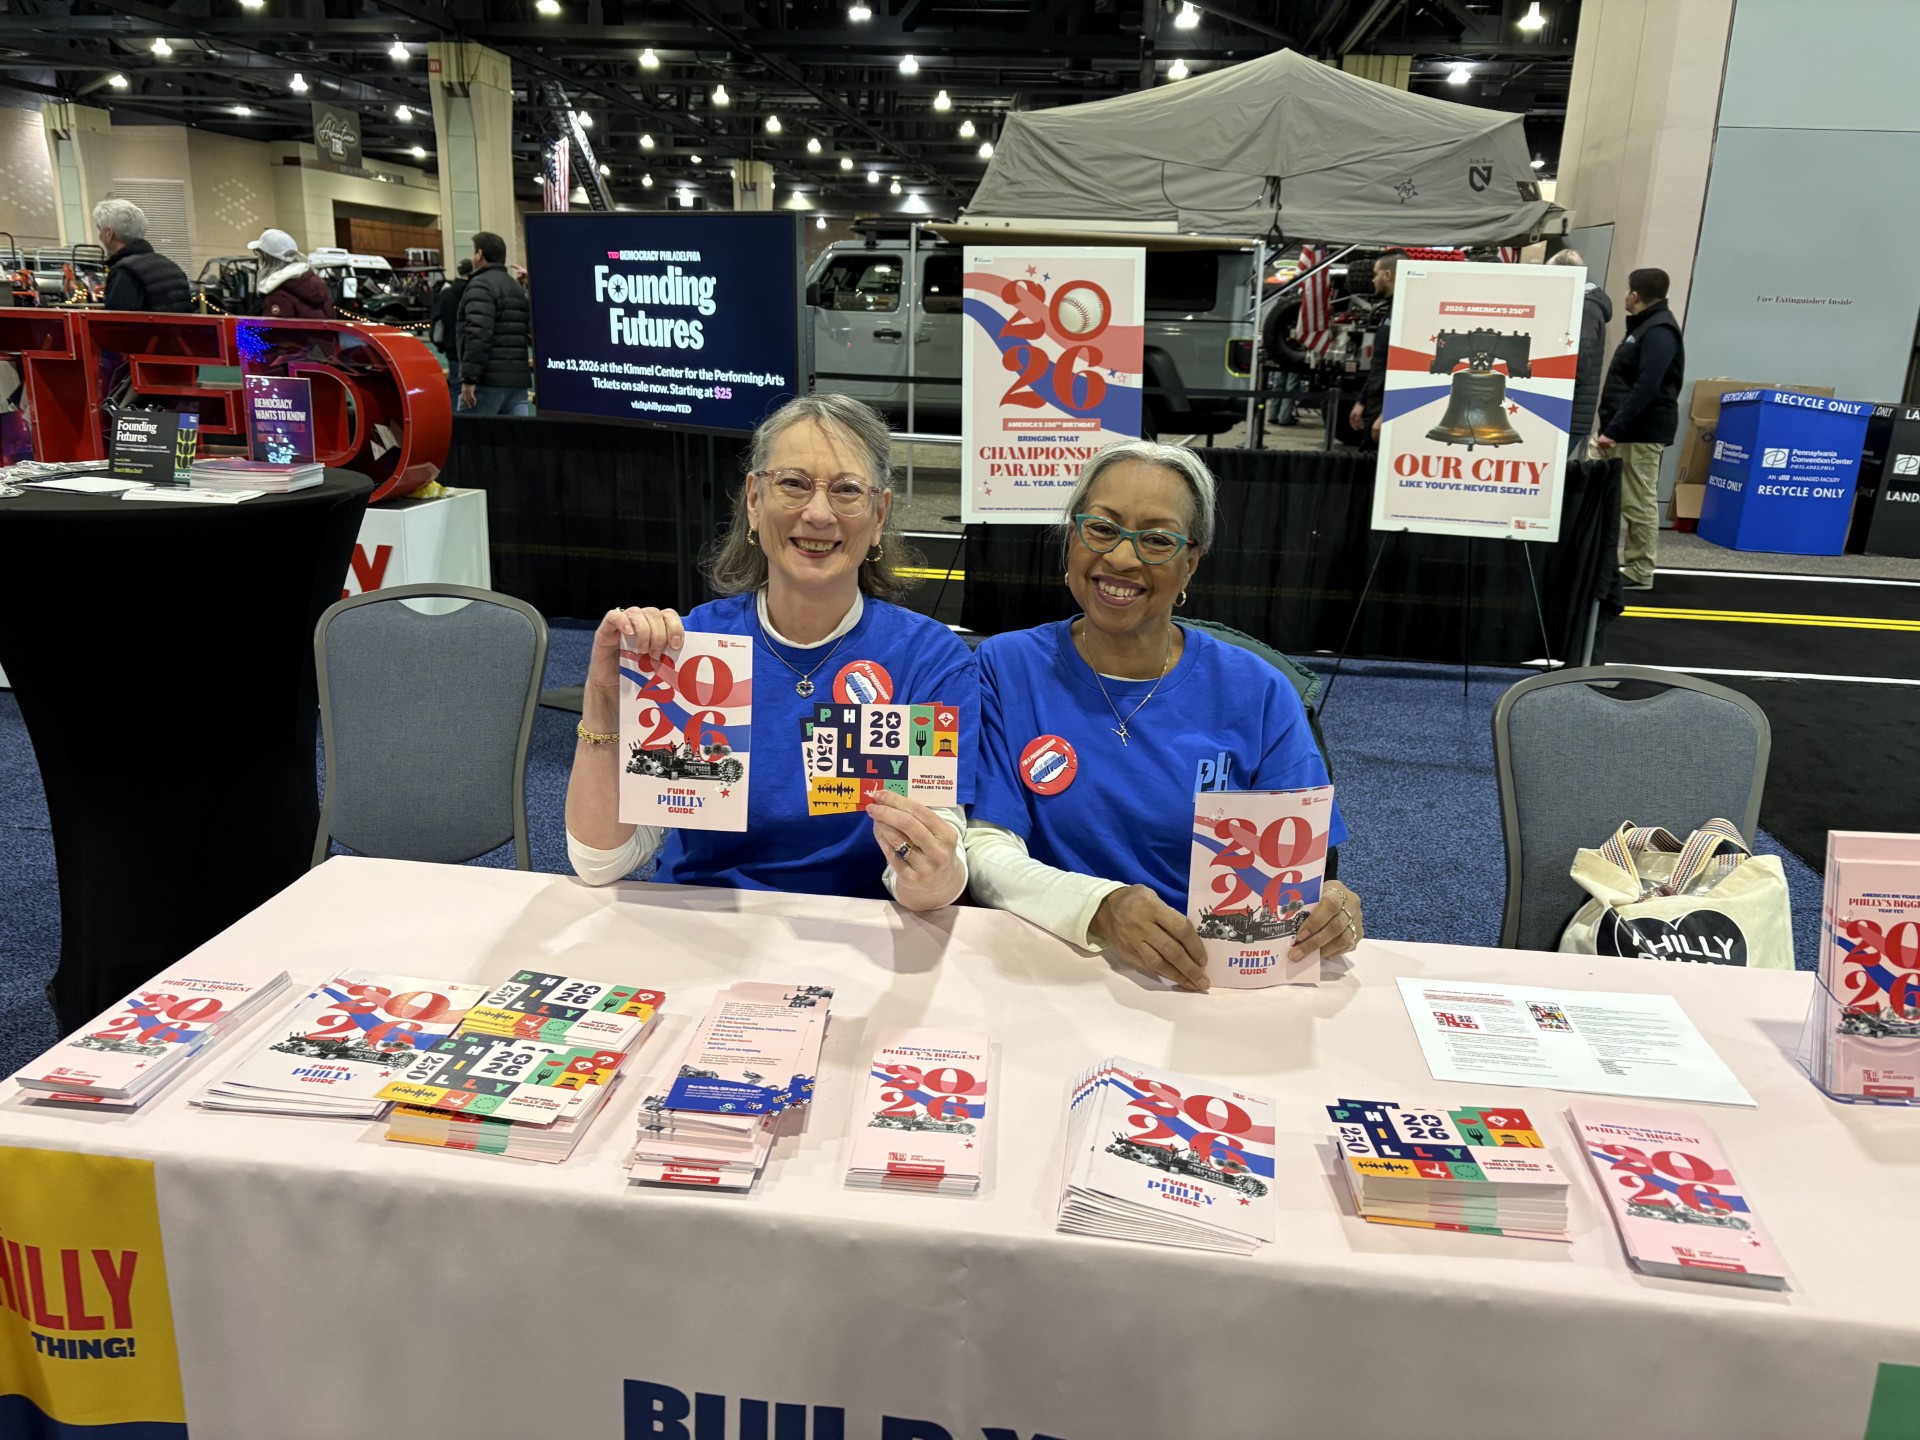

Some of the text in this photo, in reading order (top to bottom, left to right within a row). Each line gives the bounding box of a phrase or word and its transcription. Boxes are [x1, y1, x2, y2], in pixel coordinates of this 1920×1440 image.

[608, 250, 701, 262] TED DEMOCRACY PHILADELPHIA
[594, 265, 716, 316] Founding
[1757, 295, 1854, 306] Fire Extinguisher Inside
[999, 279, 1112, 342] 20
[1444, 305, 1465, 313] 2026:
[1467, 306, 1507, 314] AMERICA'S
[610, 307, 704, 350] Futures
[547, 358, 785, 387] June 13, 2026 at the Kimmel Center for the Performing Arts
[1000, 344, 1106, 411] 26
[592, 377, 732, 400] Tickets on sale now. Starting at $25
[254, 398, 292, 409] DEMOCRACY
[1722, 391, 1760, 403] RECYCLE ONLY
[1775, 393, 1824, 409] RECYCLE
[1829, 401, 1861, 415] ONLY
[631, 400, 692, 414] visitphilly.com/TED
[1876, 406, 1894, 418] ONLY
[255, 409, 306, 422] WANTS TO KNOW
[118, 420, 158, 434] Founding
[116, 431, 148, 442] Futures
[1791, 456, 1830, 464] Convention
[1792, 449, 1837, 457] Pennsylvania
[990, 463, 1059, 477] PARADE
[1394, 453, 1549, 485] OUR CITY
[1399, 480, 1540, 496] LIKE YOU'VE NEVER SEEN IT
[1709, 475, 1743, 492] RECYCLE ONLY
[1758, 484, 1845, 498] RECYCLE ONLY
[636, 653, 734, 707] 20
[869, 710, 901, 729] 20
[637, 707, 729, 763] 26
[869, 730, 900, 748] 26
[817, 733, 834, 771] 250
[685, 788, 696, 796] IN
[657, 794, 706, 809] PHILLY
[668, 806, 694, 815] GUIDE
[1209, 816, 1312, 870] 20
[1210, 870, 1303, 922] 26
[1849, 898, 1891, 907] PHILLY'S
[1843, 919, 1920, 970] 20
[1228, 955, 1279, 968] PHILLY
[161, 980, 207, 988] PHILLY'S
[208, 984, 253, 993] BIGGEST
[564, 982, 602, 995] 20
[327, 984, 451, 1021] 20
[560, 992, 593, 1005] 26
[122, 993, 223, 1023] 20
[93, 1017, 191, 1046] 26
[304, 1013, 423, 1053] 26
[491, 1051, 532, 1065] 20
[882, 1048, 981, 1060] PHILLY'S BIGGEST
[291, 1067, 357, 1082] PHILLY
[311, 1063, 334, 1071] FUN
[480, 1063, 522, 1077] 26
[300, 1077, 336, 1085] GUIDE
[880, 1064, 976, 1094] 20
[511, 1097, 540, 1105] PHILLY
[880, 1091, 970, 1123] 26
[1126, 1079, 1252, 1134] 20
[1400, 1114, 1443, 1127] 20
[1339, 1126, 1370, 1154] 250
[1409, 1127, 1450, 1140] 26
[1585, 1125, 1643, 1137] PHILLY'S
[1645, 1132, 1700, 1144] BIGGEST
[1127, 1114, 1247, 1174] 26
[1602, 1144, 1715, 1182] 20
[1147, 1179, 1216, 1205] PHILLY
[1162, 1177, 1203, 1193] FUN IN
[1162, 1193, 1200, 1208] GUIDE
[1618, 1175, 1734, 1216] 26
[31, 1331, 136, 1360] THING!
